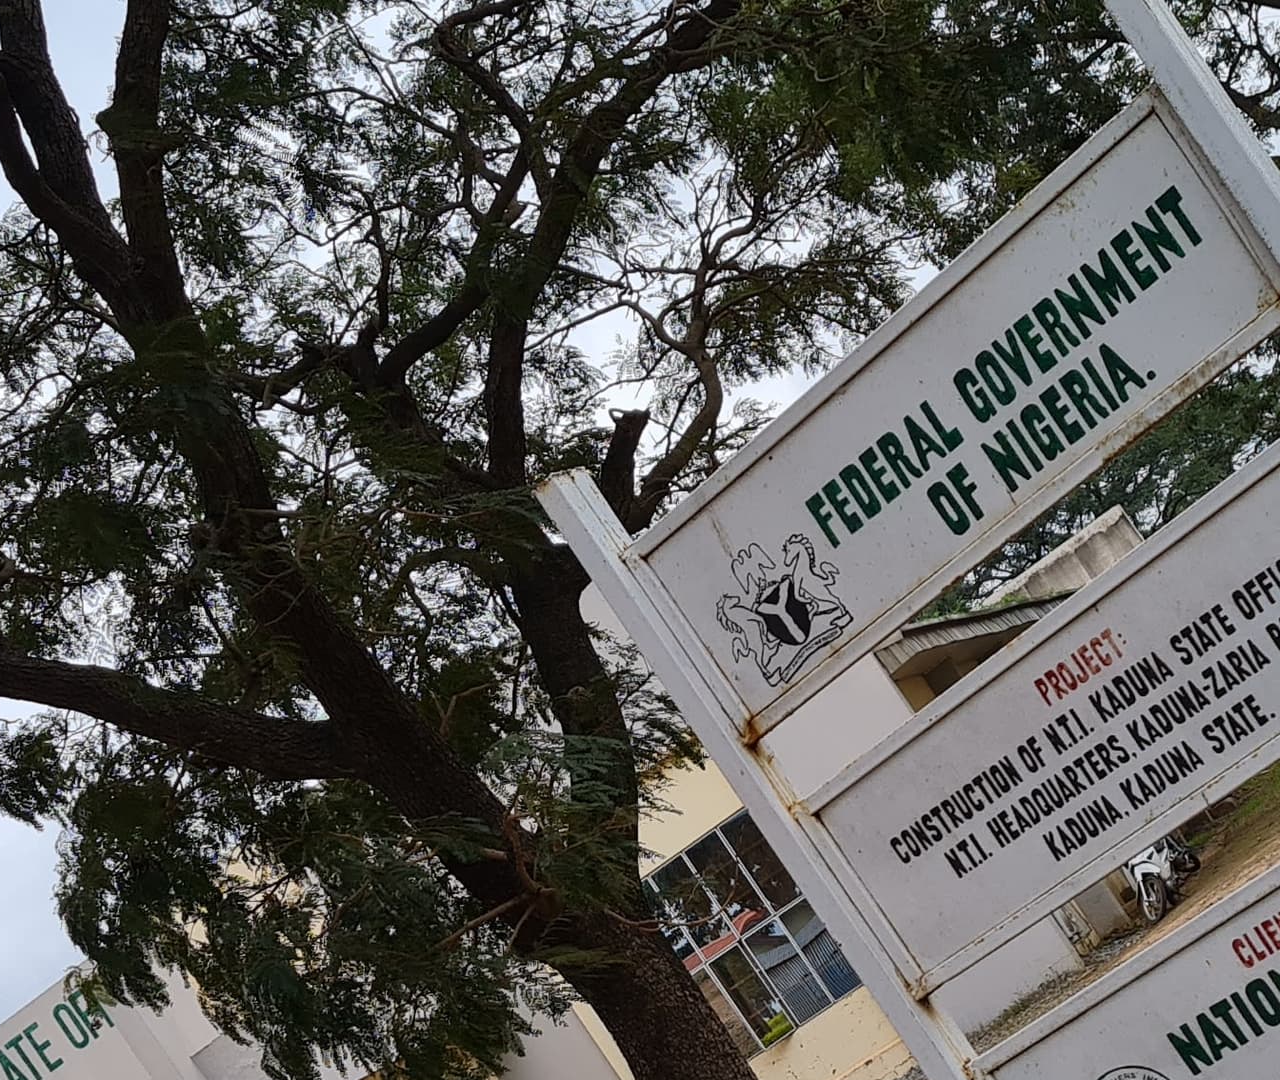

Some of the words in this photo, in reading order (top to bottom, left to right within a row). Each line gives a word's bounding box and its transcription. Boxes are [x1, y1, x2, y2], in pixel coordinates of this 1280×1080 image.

[805, 400, 964, 548] FEDERAL
[953, 185, 1202, 423] GOVERNMENT
[927, 462, 984, 535] OF
[983, 344, 1156, 494] NIGERIA.
[890, 756, 1023, 864] CONSTRUCTION
[1017, 738, 1046, 774] OF
[1044, 708, 1095, 755] N.T.I.
[1088, 651, 1175, 723] KADUNA
[1169, 603, 1237, 666] STATE
[945, 833, 993, 879] N.T.I.
[991, 735, 1138, 849] HEADQUARTERS,
[1126, 641, 1271, 751] KADUNA-ZARIA
[1034, 627, 1128, 707] PROJECT:
[1042, 796, 1130, 861] KADUNA,
[1119, 740, 1205, 811] KADUNA
[1202, 694, 1276, 754] STATE.
